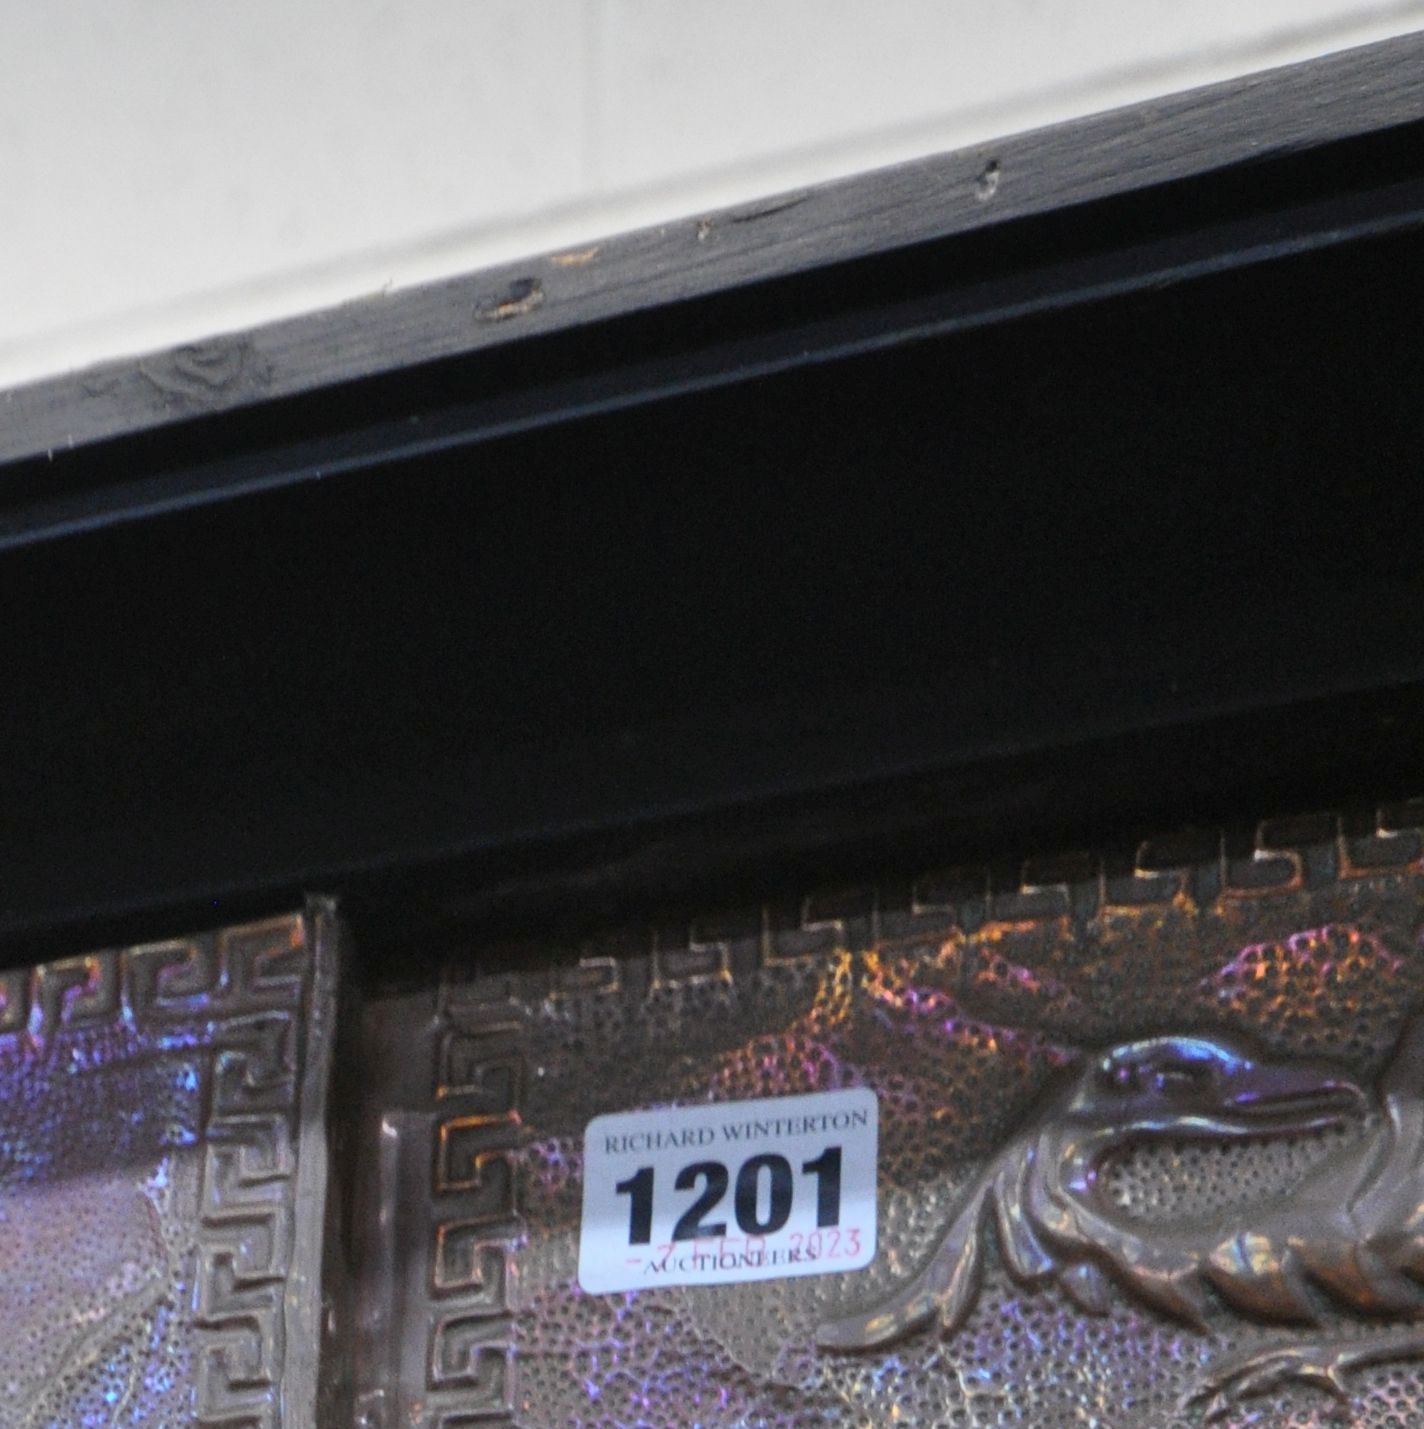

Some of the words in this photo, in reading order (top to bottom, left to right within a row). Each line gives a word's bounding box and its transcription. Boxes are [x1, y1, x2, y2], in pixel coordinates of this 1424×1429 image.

[605, 1127, 714, 1154] RICHARD
[723, 1110, 867, 1140] WINTERTON
[616, 1146, 842, 1245] 1201
[643, 1247, 817, 1275] AUCTIONEERS
[789, 1228, 862, 1262] 2023
